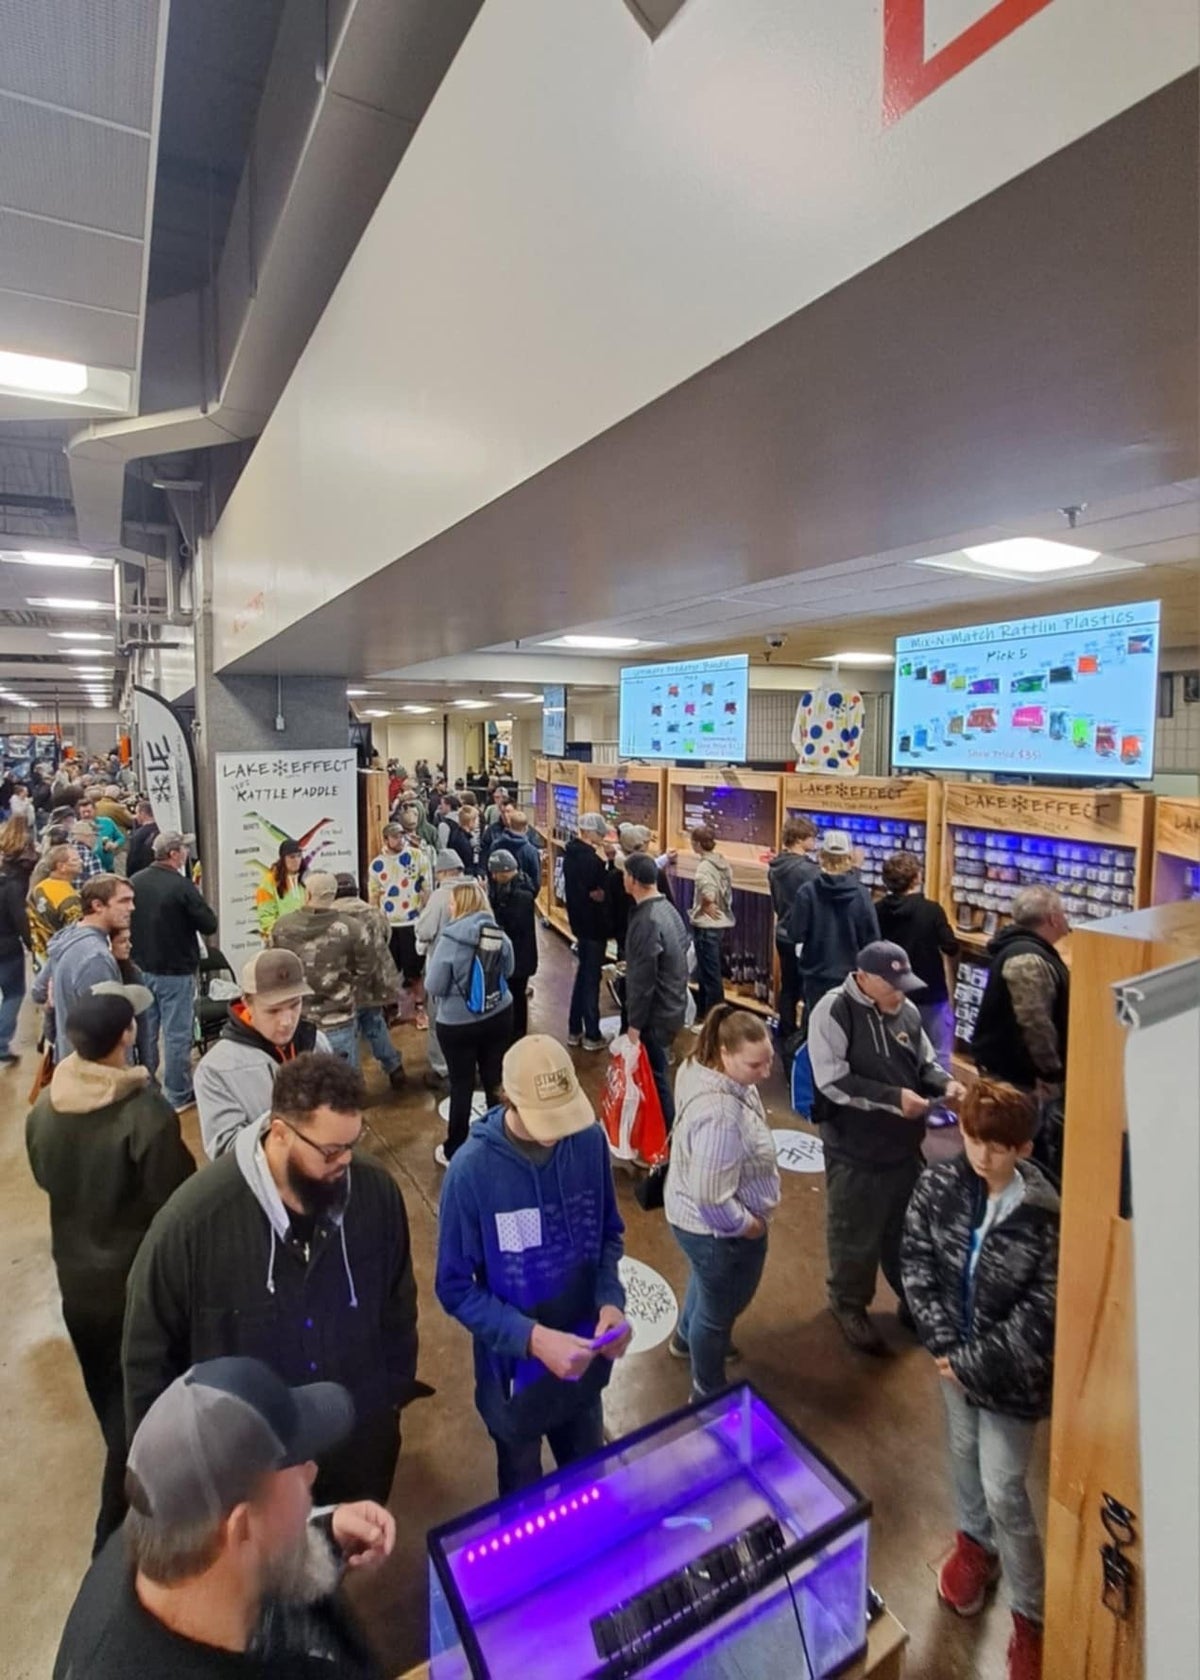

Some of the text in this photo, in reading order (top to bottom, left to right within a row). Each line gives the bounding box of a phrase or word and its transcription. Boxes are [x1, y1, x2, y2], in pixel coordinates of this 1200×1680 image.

[910, 611, 1135, 649] Mix-N-Match Rattlin Plastics
[986, 650, 1014, 662] Pick
[223, 758, 355, 779] LAKE EFFECT
[237, 785, 339, 802] RATTLE PADDLE
[799, 782, 908, 800] LAKE EFFECT
[964, 794, 1111, 819] LAKE EFFECT
